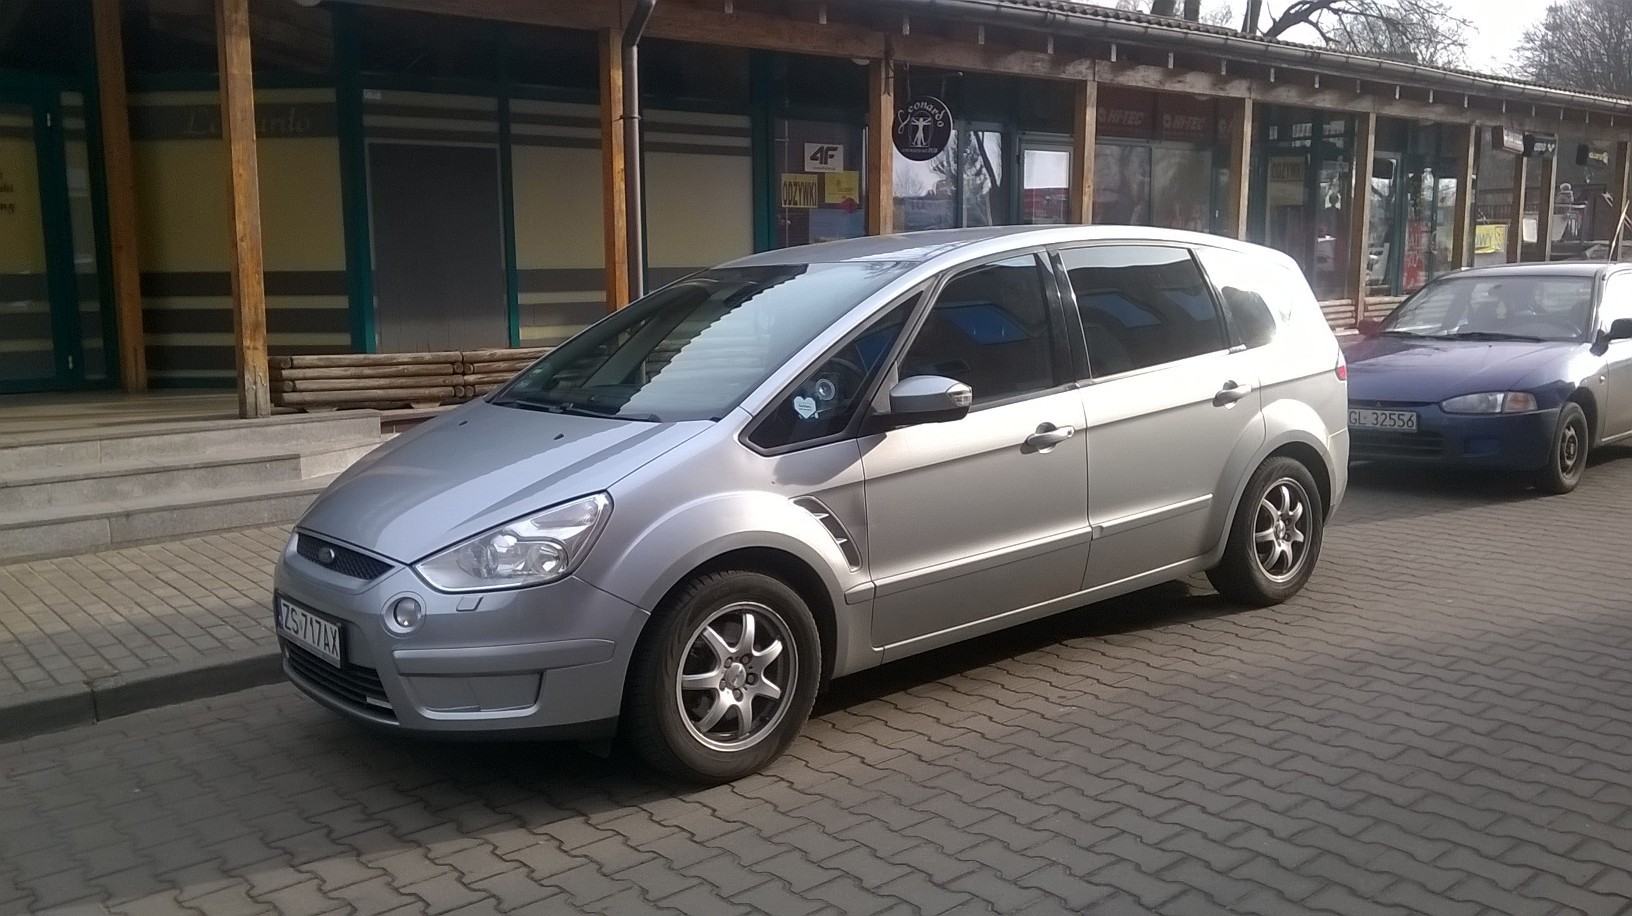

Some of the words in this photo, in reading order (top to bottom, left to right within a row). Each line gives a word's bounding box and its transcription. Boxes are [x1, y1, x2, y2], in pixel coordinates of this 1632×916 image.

[897, 101, 947, 135] Leonardo
[809, 145, 839, 165] 4F
[1349, 410, 1366, 425] GL
[1371, 411, 1415, 429] 32556
